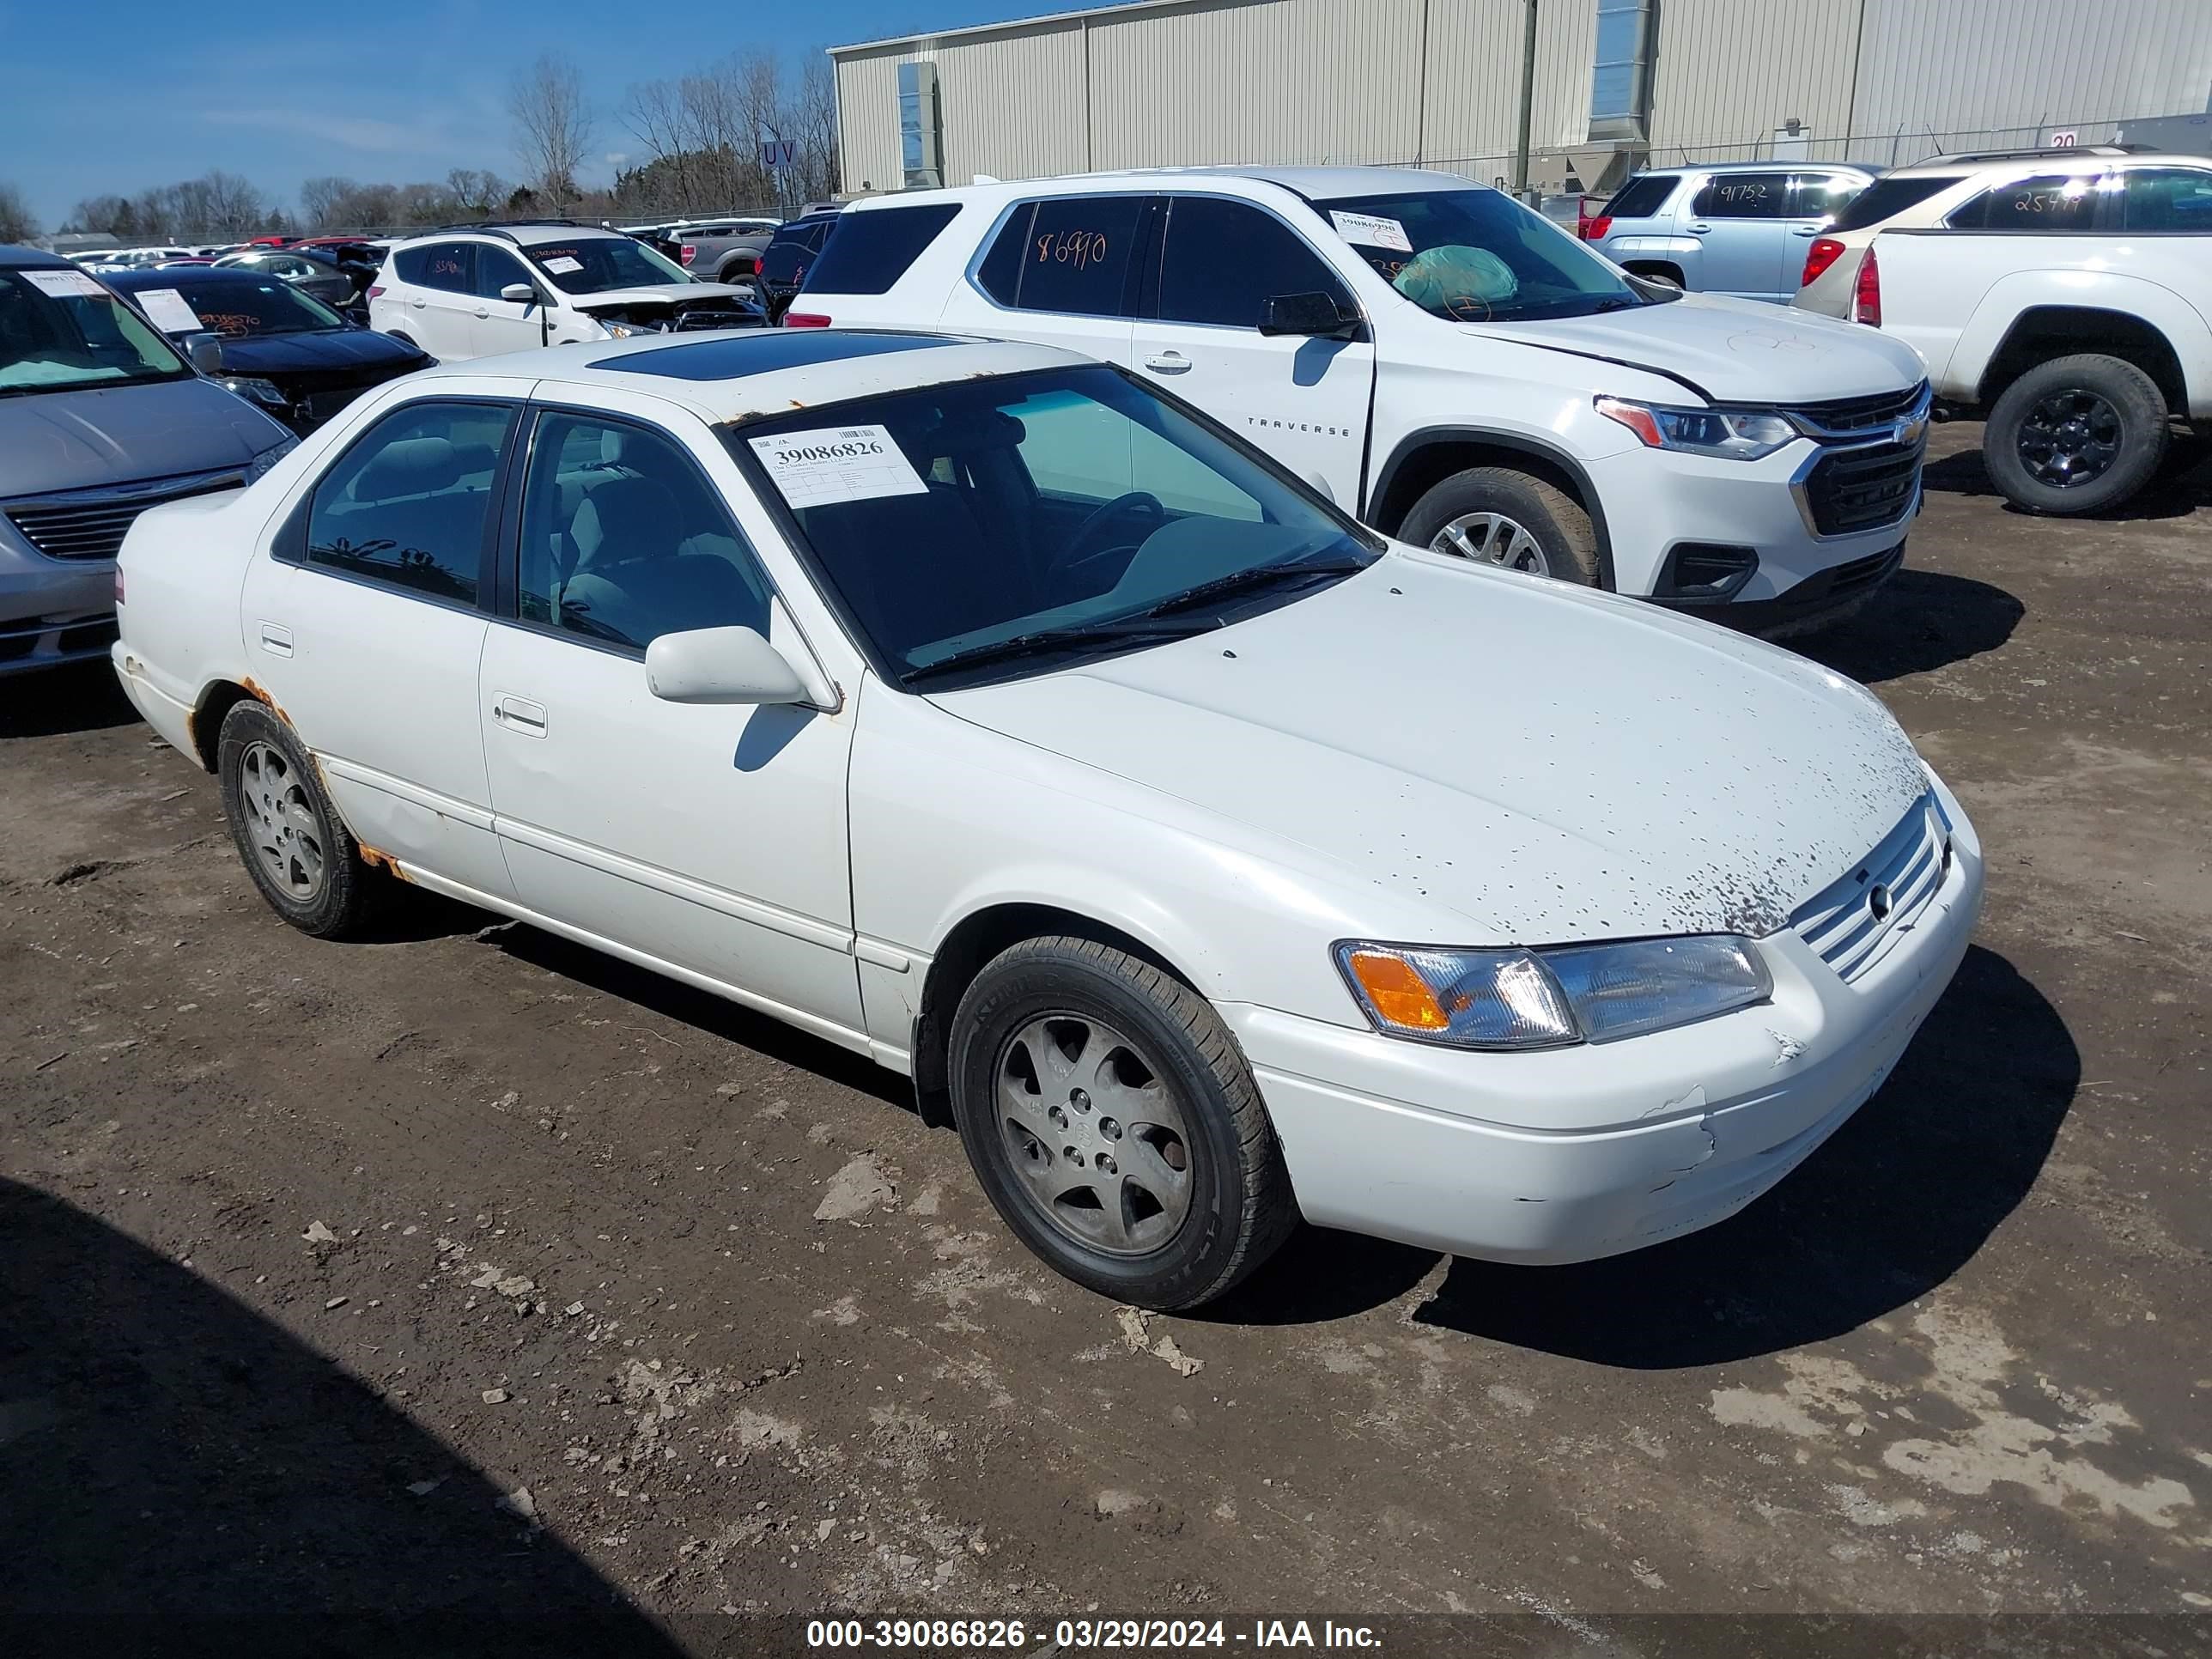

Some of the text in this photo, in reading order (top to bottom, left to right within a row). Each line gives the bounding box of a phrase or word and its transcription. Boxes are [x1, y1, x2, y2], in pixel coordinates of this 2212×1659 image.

[1720, 184, 1768, 202] 91752
[1340, 217, 1396, 232] 39086990
[1037, 230, 1106, 271] 86990
[1248, 416, 1350, 437] TRAVERSE
[774, 441, 884, 465] 39086826
